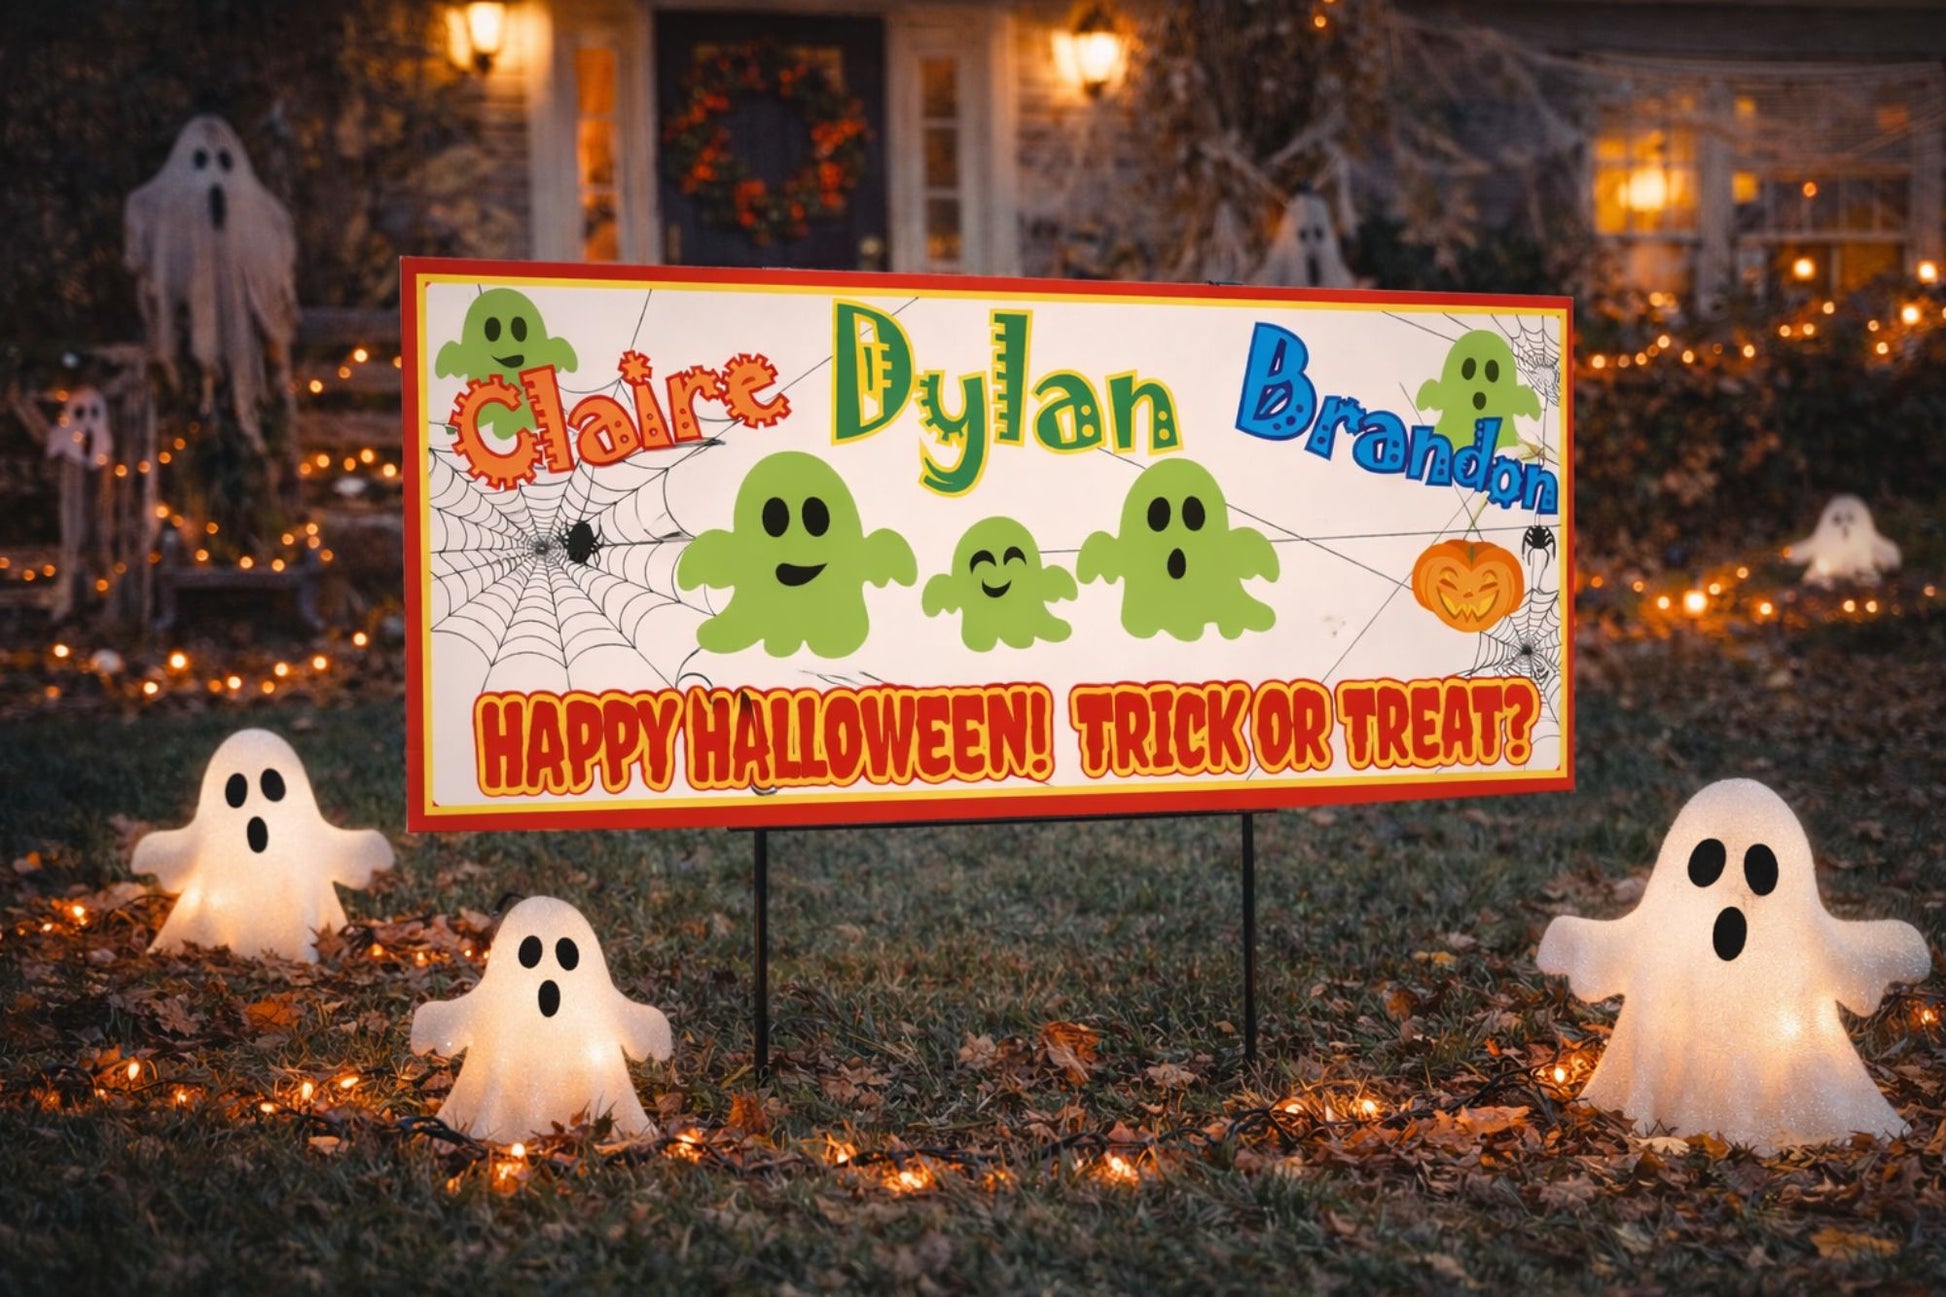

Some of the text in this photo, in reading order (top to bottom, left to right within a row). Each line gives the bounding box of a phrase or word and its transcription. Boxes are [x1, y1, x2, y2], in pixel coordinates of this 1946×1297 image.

[449, 297, 1559, 515] Claire Dylan Brandon
[474, 677, 1541, 797] HAPPY HALLOWEEN! TRICK OR TREAT?
